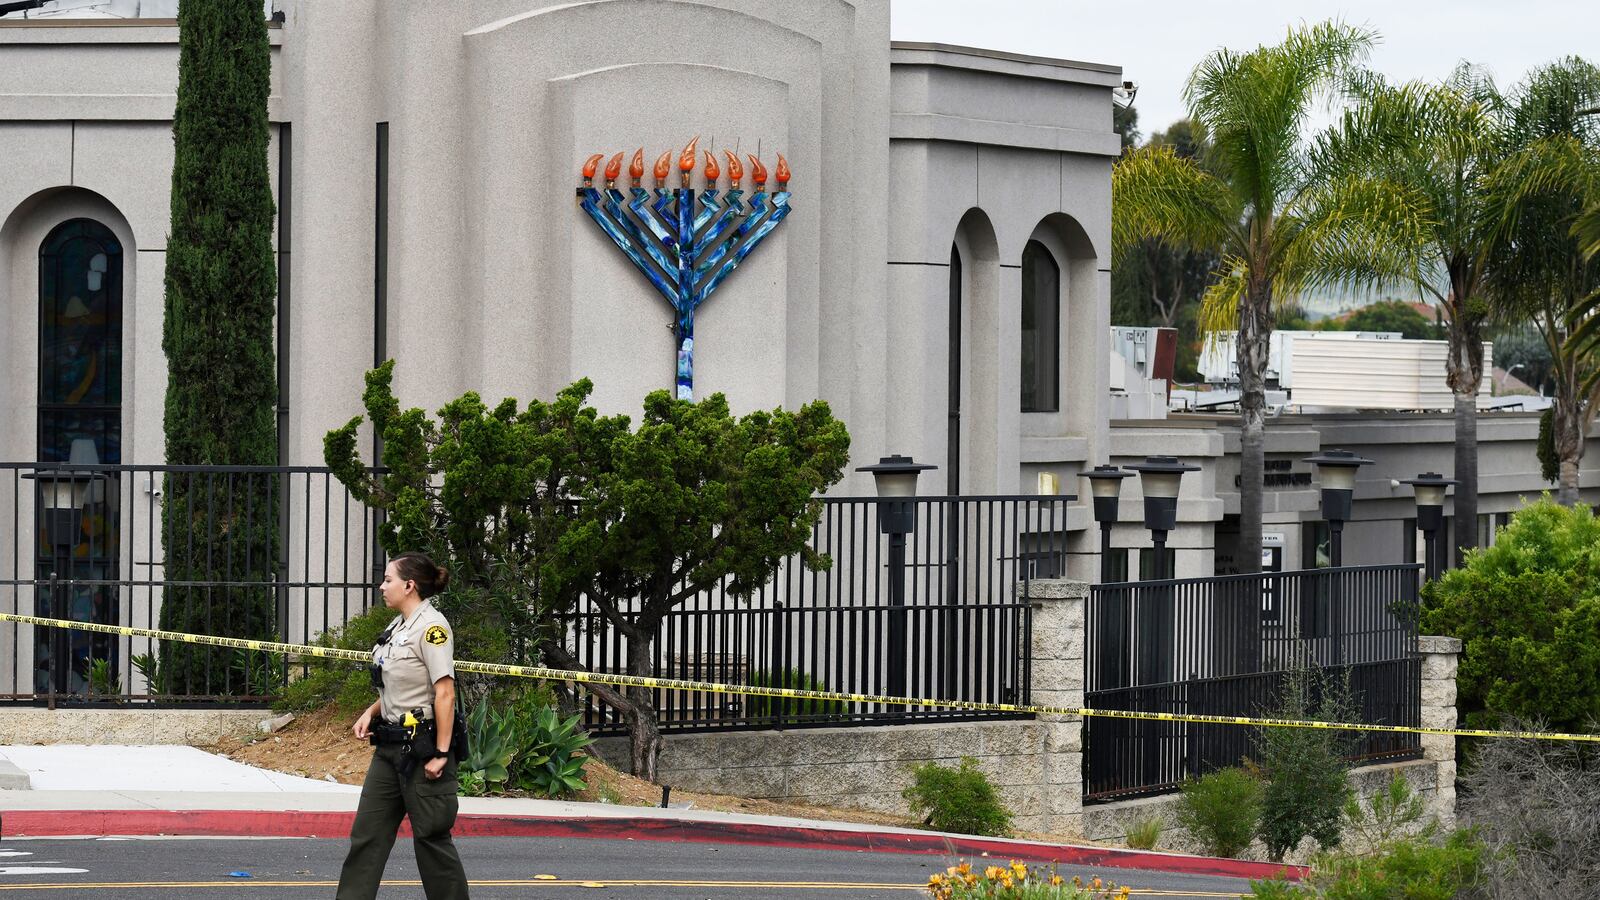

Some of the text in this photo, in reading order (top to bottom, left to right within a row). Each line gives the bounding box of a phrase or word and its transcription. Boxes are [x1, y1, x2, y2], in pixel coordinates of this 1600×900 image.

[454, 660, 471, 670] SHERIFF
[496, 665, 510, 674] CROSS
[520, 667, 537, 676] SHERIFF
[563, 671, 578, 680] CROSS
